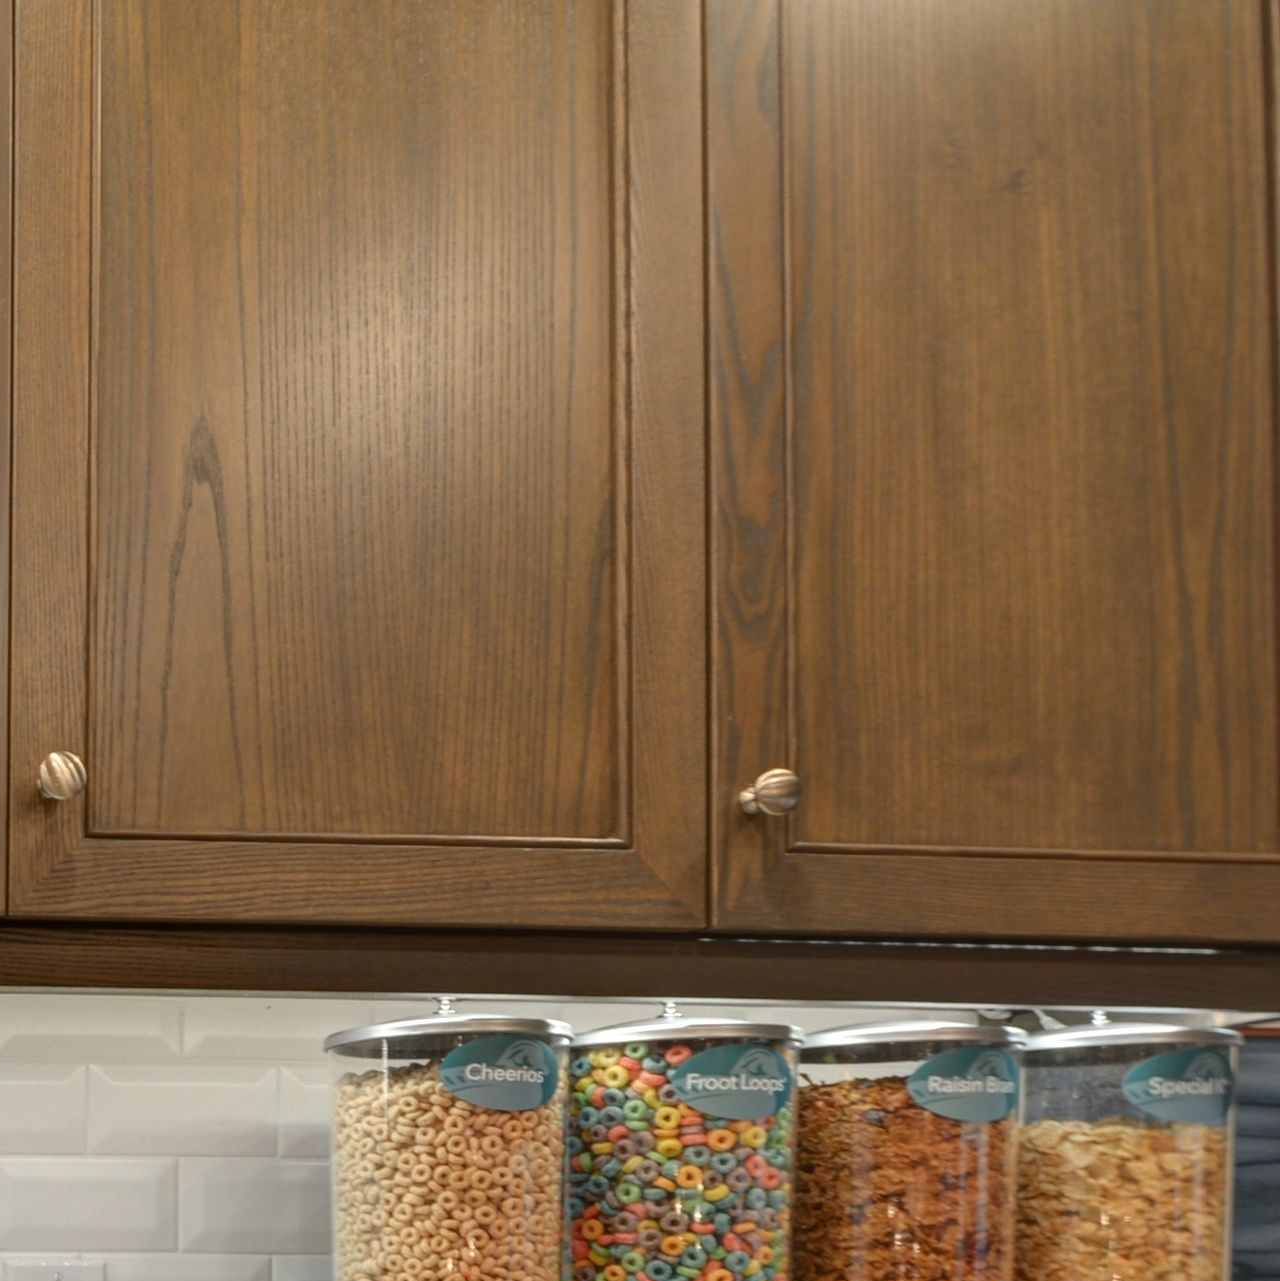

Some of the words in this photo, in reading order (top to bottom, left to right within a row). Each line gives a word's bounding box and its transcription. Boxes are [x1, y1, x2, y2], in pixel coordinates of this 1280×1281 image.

[465, 1063, 545, 1083] Cheerios
[686, 1073, 739, 1091] Froot
[740, 1073, 785, 1095] Loops
[927, 1075, 984, 1093] Raisin
[1148, 1076, 1213, 1099] Special
